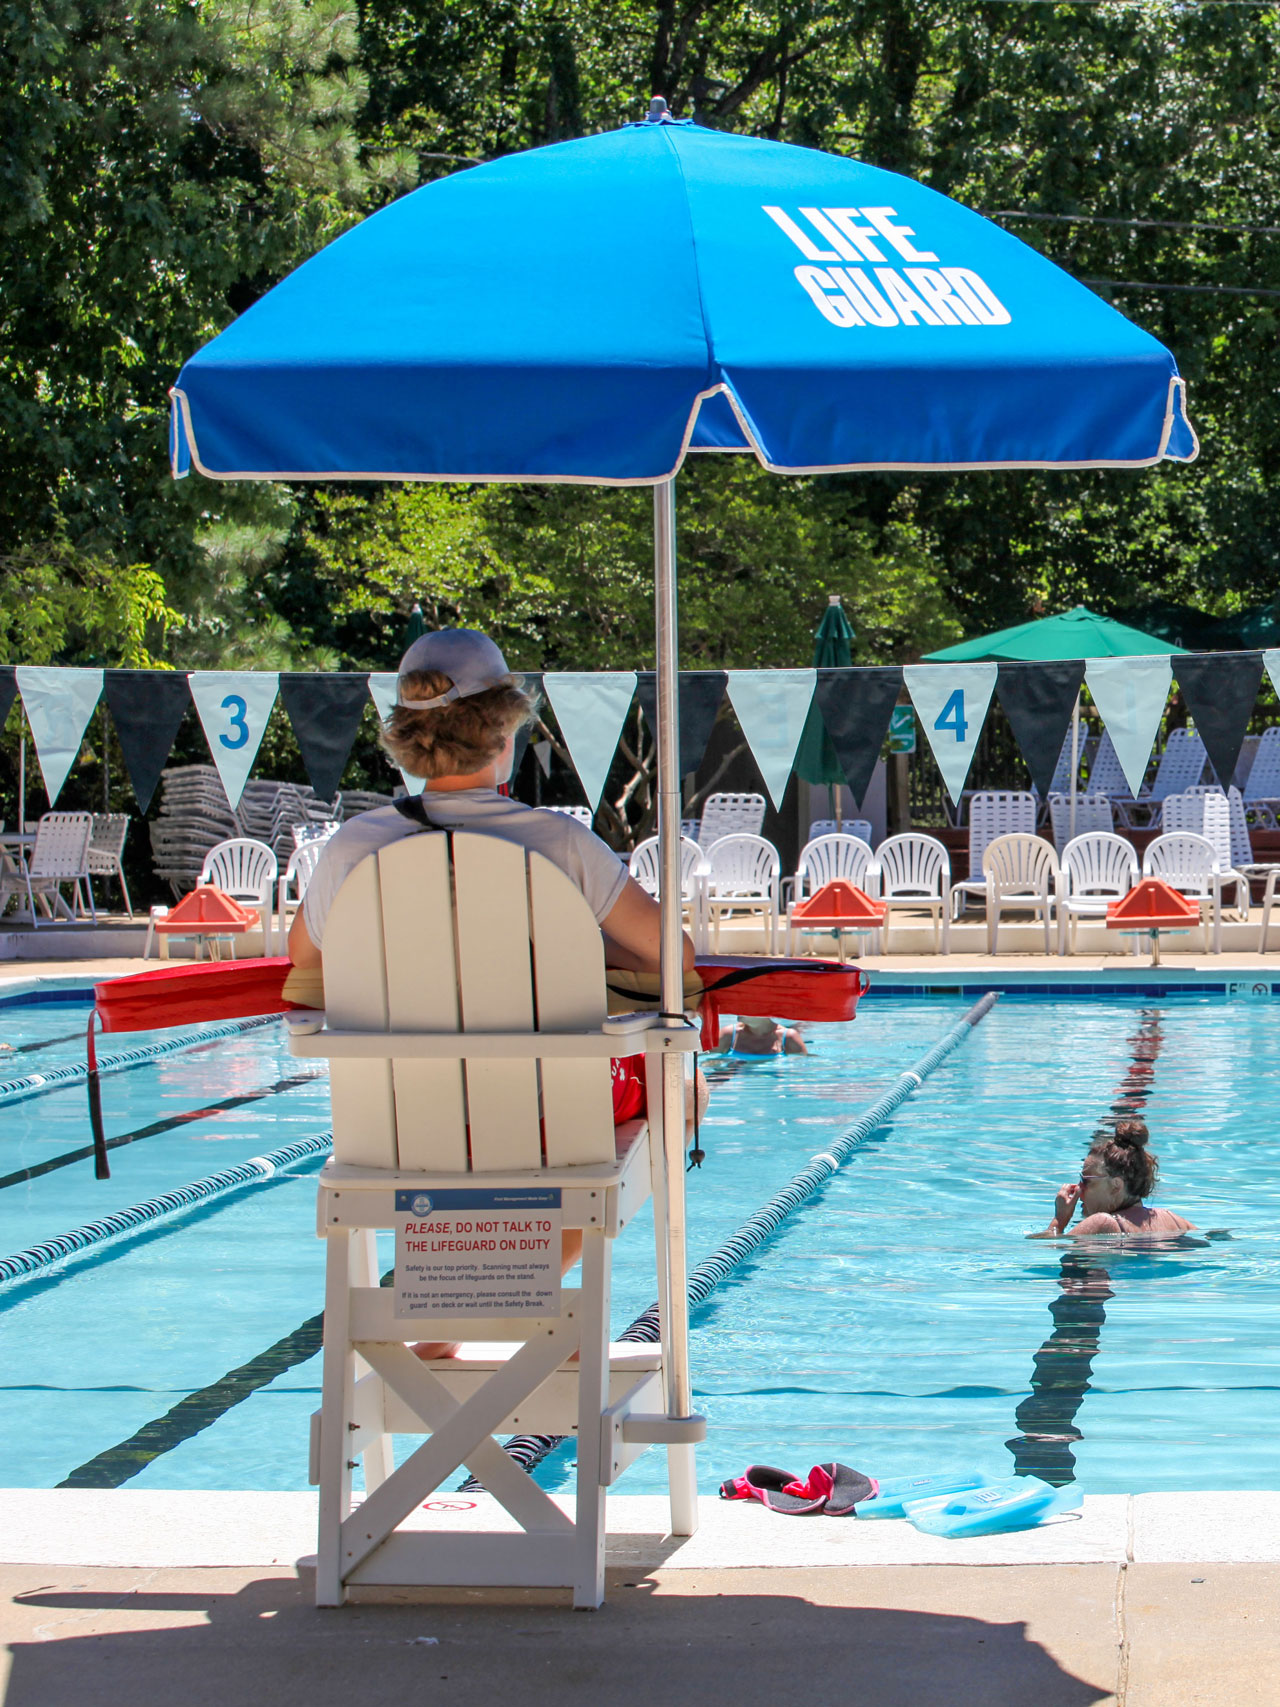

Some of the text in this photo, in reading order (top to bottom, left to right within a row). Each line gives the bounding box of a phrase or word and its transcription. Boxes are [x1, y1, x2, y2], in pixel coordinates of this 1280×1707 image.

[761, 205, 940, 262] LIFE
[793, 265, 1012, 328] GUARD
[219, 694, 250, 750] 3
[934, 689, 968, 742] 4
[405, 1221, 552, 1235] PLEASE, DO NOT TALK TO
[405, 1239, 550, 1252] THE LIFEGUARD ON DUTY
[529, 1263, 550, 1271] always
[465, 1274, 495, 1282] lifeguards
[505, 1300, 524, 1308] Safety
